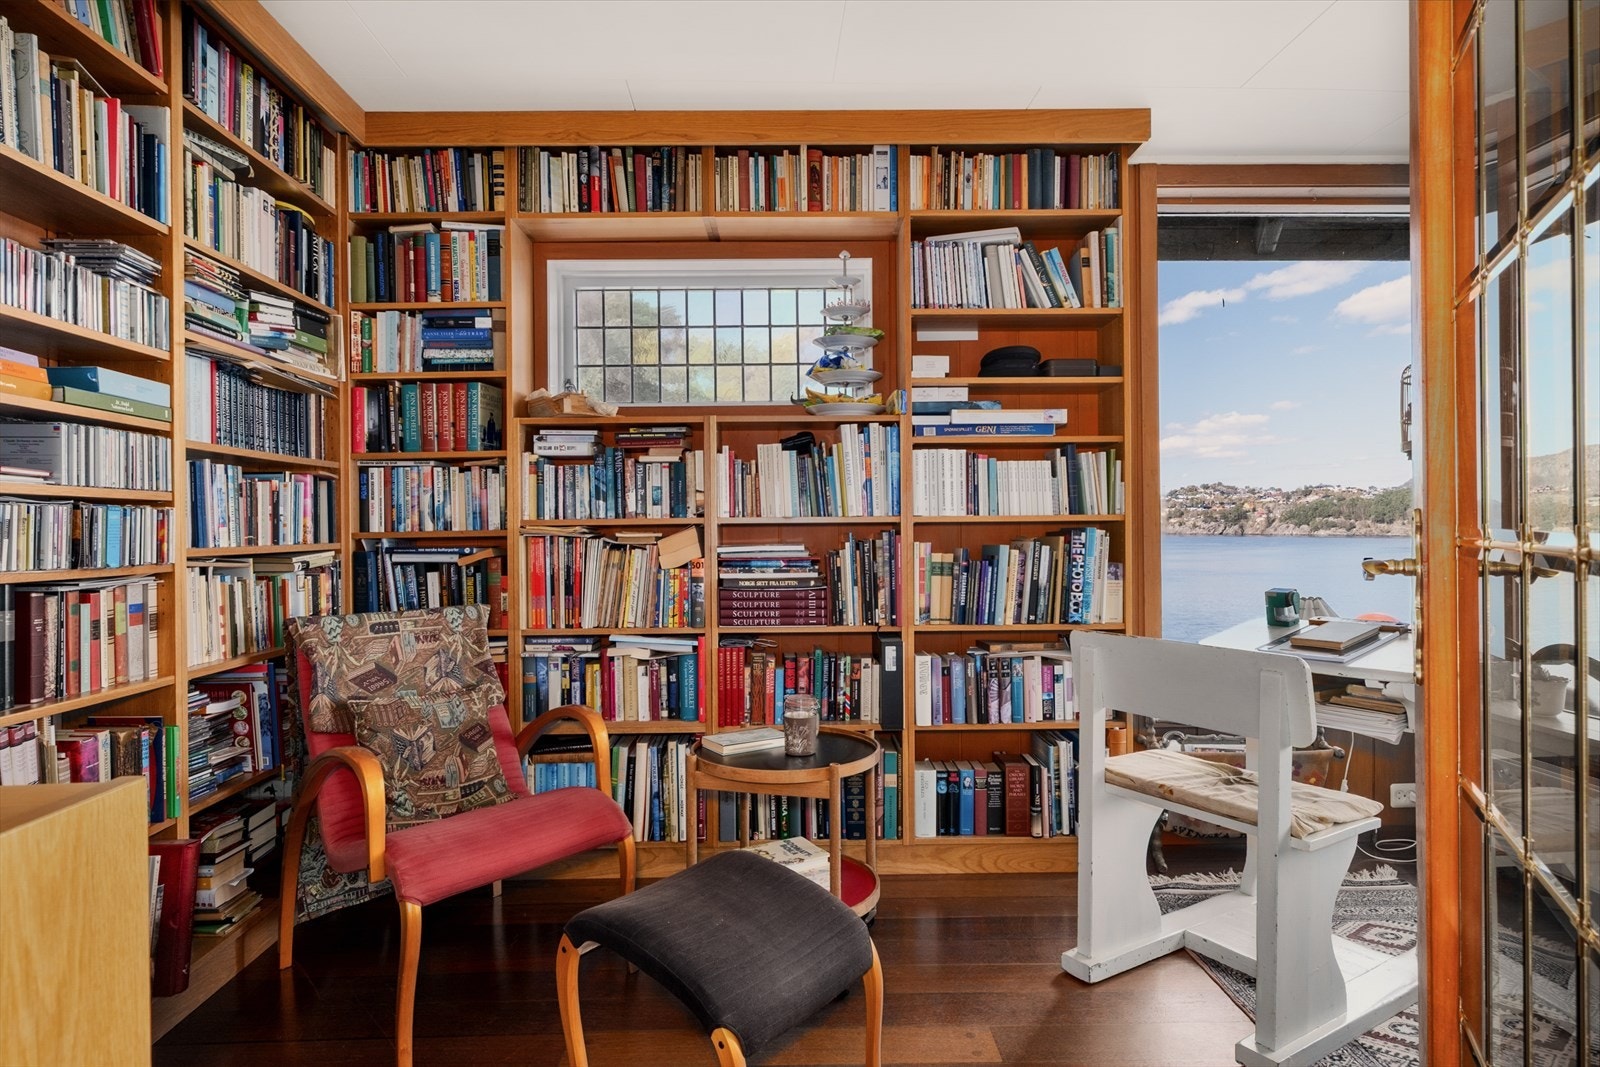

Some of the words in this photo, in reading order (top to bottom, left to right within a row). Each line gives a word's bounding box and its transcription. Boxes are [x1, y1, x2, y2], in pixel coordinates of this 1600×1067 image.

[425, 391, 433, 404] JON
[975, 425, 997, 435] GENI
[1073, 532, 1086, 554] THE
[1171, 826, 1230, 839] SVENSKA
